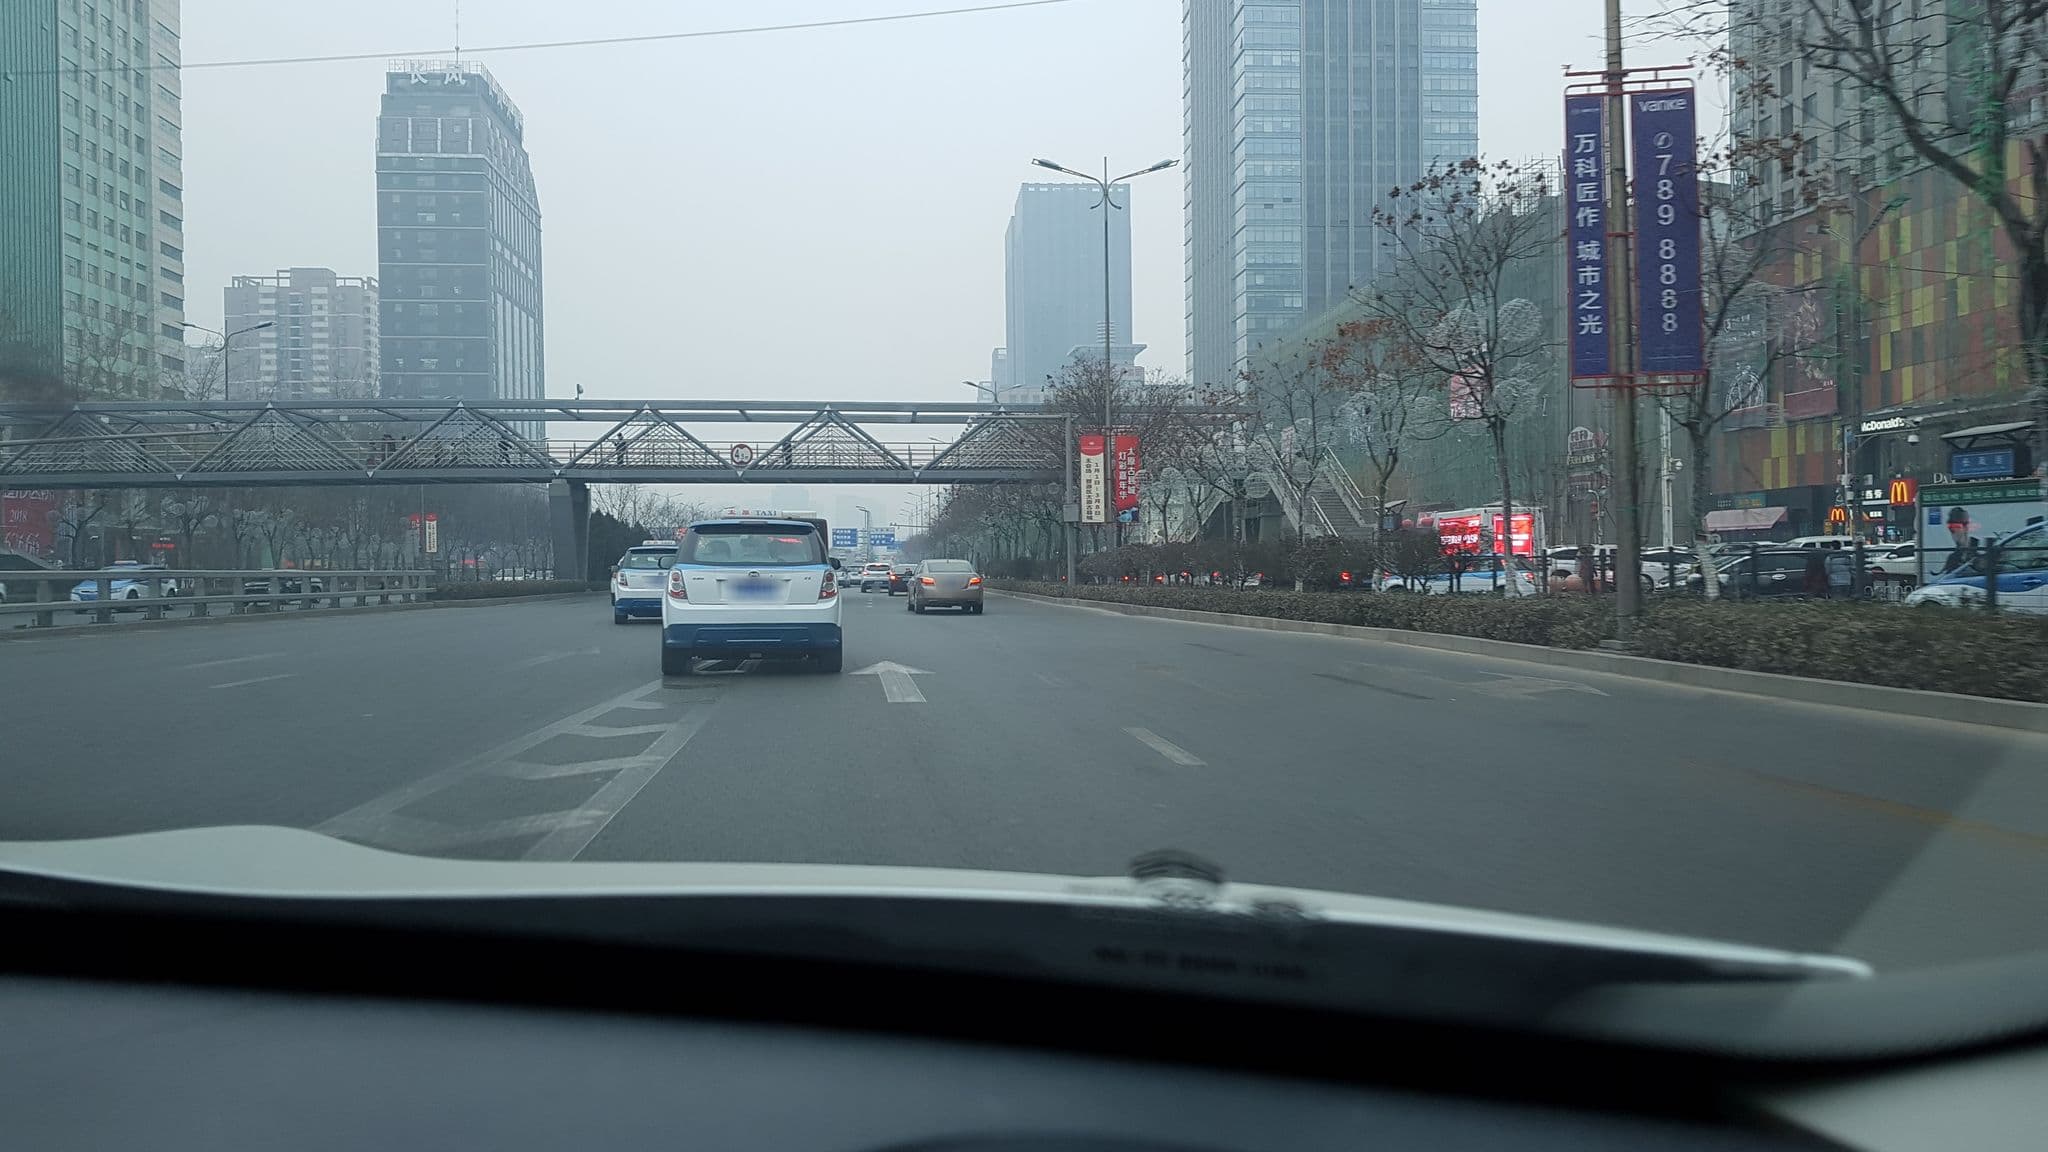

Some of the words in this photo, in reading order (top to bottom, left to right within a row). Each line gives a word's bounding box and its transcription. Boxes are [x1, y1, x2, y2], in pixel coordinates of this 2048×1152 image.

[1638, 98, 1688, 112] vanke
[1573, 133, 1600, 227] 万科匠作
[1655, 154, 1676, 226] 789
[1576, 240, 1603, 335] 城市之光
[1658, 238, 1678, 335] 8888
[756, 509, 777, 517] TAXI
